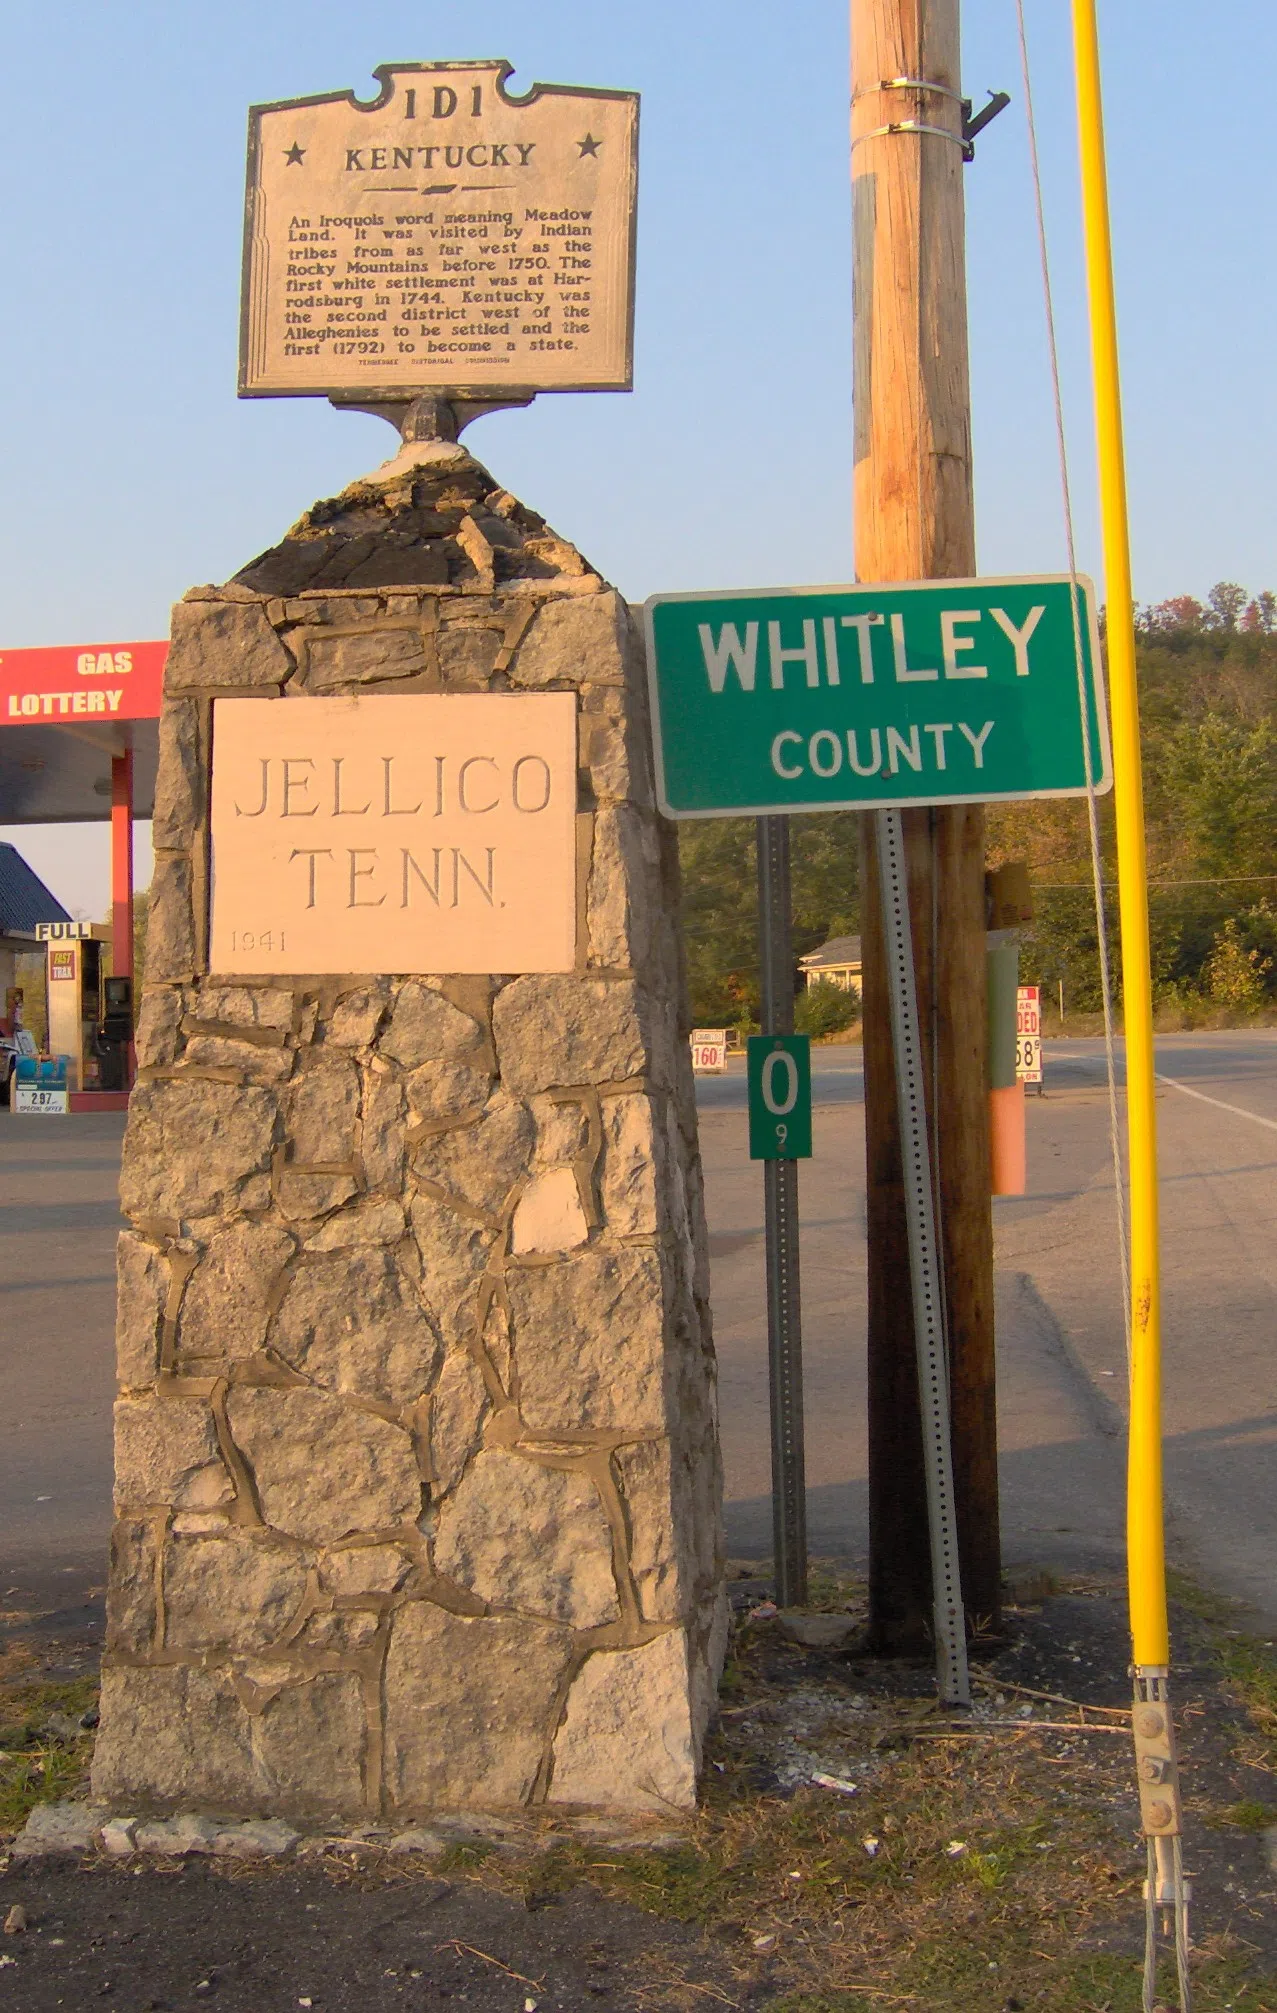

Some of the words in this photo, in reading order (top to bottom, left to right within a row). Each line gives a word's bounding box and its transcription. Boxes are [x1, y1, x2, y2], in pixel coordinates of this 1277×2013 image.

[345, 144, 536, 171] KENTUCKY
[290, 216, 310, 228] An
[320, 214, 384, 228] Iroquois
[395, 213, 433, 225] word
[444, 211, 513, 225] meaning
[525, 209, 592, 221] Meadow
[288, 229, 335, 241] Land.
[355, 228, 366, 240] It
[383, 229, 413, 239] was
[430, 226, 488, 238] visited
[504, 225, 523, 239] by
[541, 224, 592, 236] Indian
[289, 248, 337, 260] tribes
[354, 246, 393, 257] from
[407, 247, 424, 256] as
[439, 244, 463, 256] far
[479, 242, 517, 254] west
[532, 244, 550, 252] as
[565, 240, 592, 252] the
[287, 263, 336, 276] Rocky
[347, 261, 428, 273] Mountains
[442, 260, 496, 271] before
[509, 257, 550, 270] 1750.
[559, 256, 592, 268] The
[286, 279, 322, 291] first
[333, 278, 376, 290] white
[386, 276, 475, 289] settlement
[489, 277, 517, 286] was
[528, 274, 543, 285] at
[554, 273, 591, 285] Har-
[286, 295, 363, 309] rodsburg
[375, 293, 390, 305] in
[400, 292, 444, 304] 1744.
[462, 290, 544, 304] Kentucky
[559, 291, 590, 301] was
[285, 312, 312, 324] the
[327, 310, 387, 322] second
[401, 307, 466, 321] district
[481, 307, 519, 318] west
[533, 306, 550, 318] of
[563, 305, 590, 317] the
[284, 326, 379, 342] Alleghenies
[393, 325, 409, 337] to
[421, 324, 441, 336] be
[452, 323, 510, 335] settled
[522, 322, 552, 334] and
[562, 322, 590, 333] the
[284, 343, 320, 355] first
[333, 342, 384, 354] (1792)
[398, 341, 415, 353] to
[428, 340, 491, 353] become
[507, 342, 515, 351] a
[530, 338, 578, 350] state.
[698, 606, 1046, 693] WHITLEY
[77, 652, 132, 675] GAS
[9, 690, 123, 716] LOTTERY
[770, 721, 995, 779] COUNTY
[234, 755, 551, 818] JELLICO
[288, 848, 506, 909] TENN.
[39, 923, 88, 939] FULL
[231, 930, 286, 951] 1941
[695, 1048, 717, 1065] 160
[762, 1050, 798, 1115] 0
[776, 1124, 787, 1144] 9
